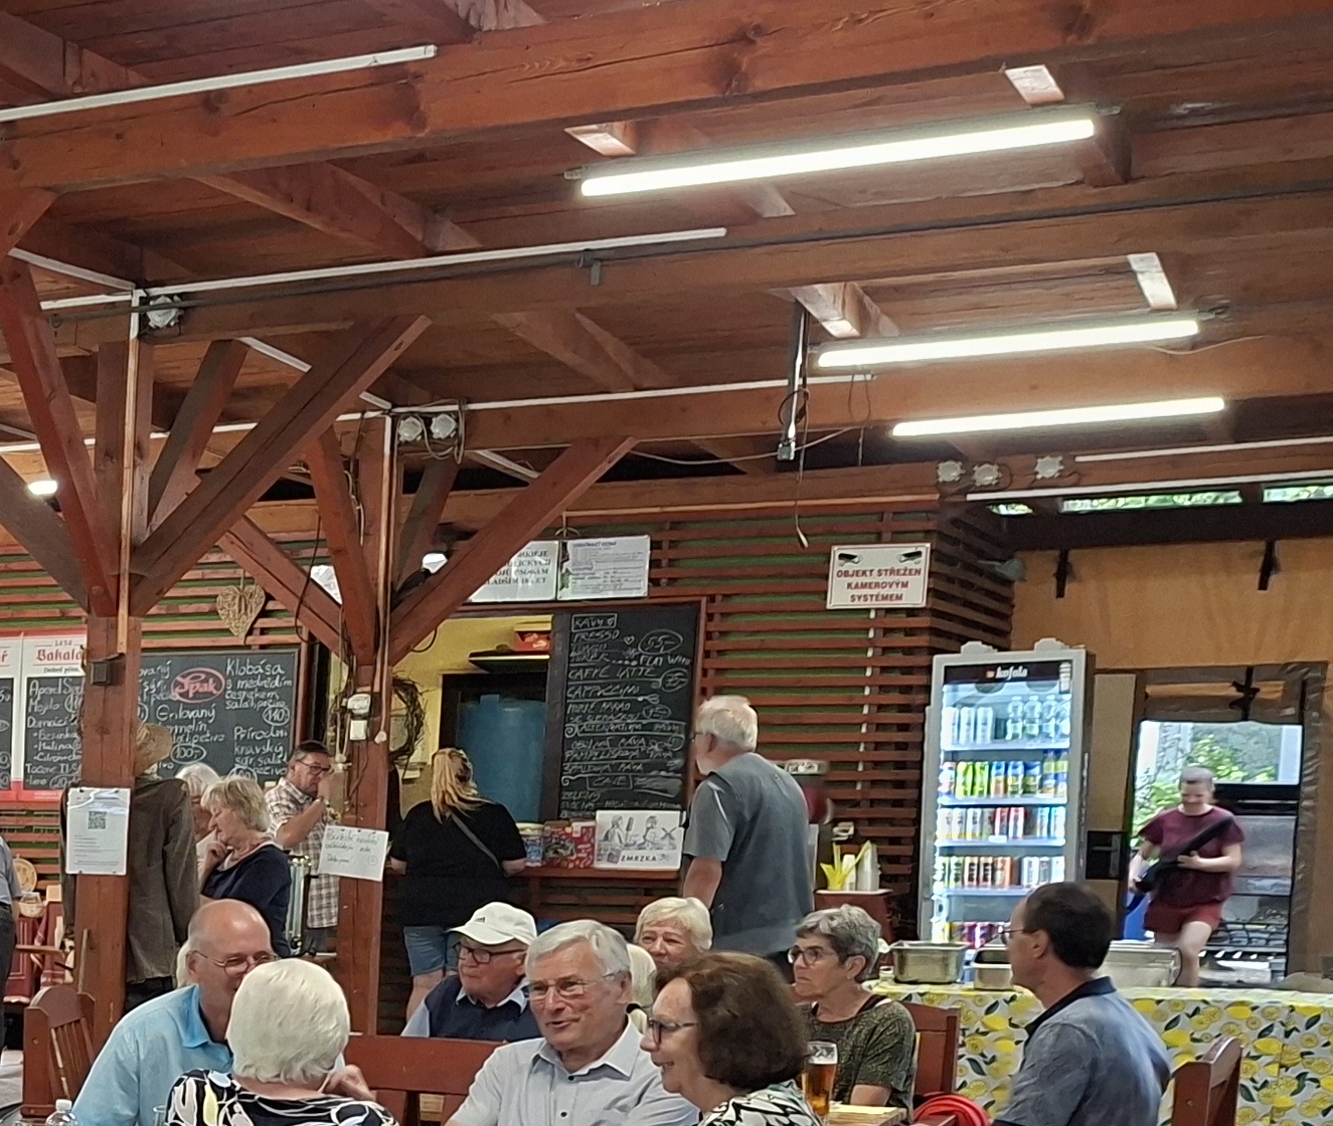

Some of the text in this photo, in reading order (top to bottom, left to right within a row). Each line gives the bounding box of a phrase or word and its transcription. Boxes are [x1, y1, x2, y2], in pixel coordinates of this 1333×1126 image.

[836, 566, 922, 578] OBJEKT STŘEŽEN
[846, 579, 909, 590] KAMEROVÝM
[850, 592, 904, 603] SYSTÉMEM
[36, 649, 83, 662] Bakal
[226, 658, 286, 675] Klobása
[620, 854, 658, 863] ZMRZKA
